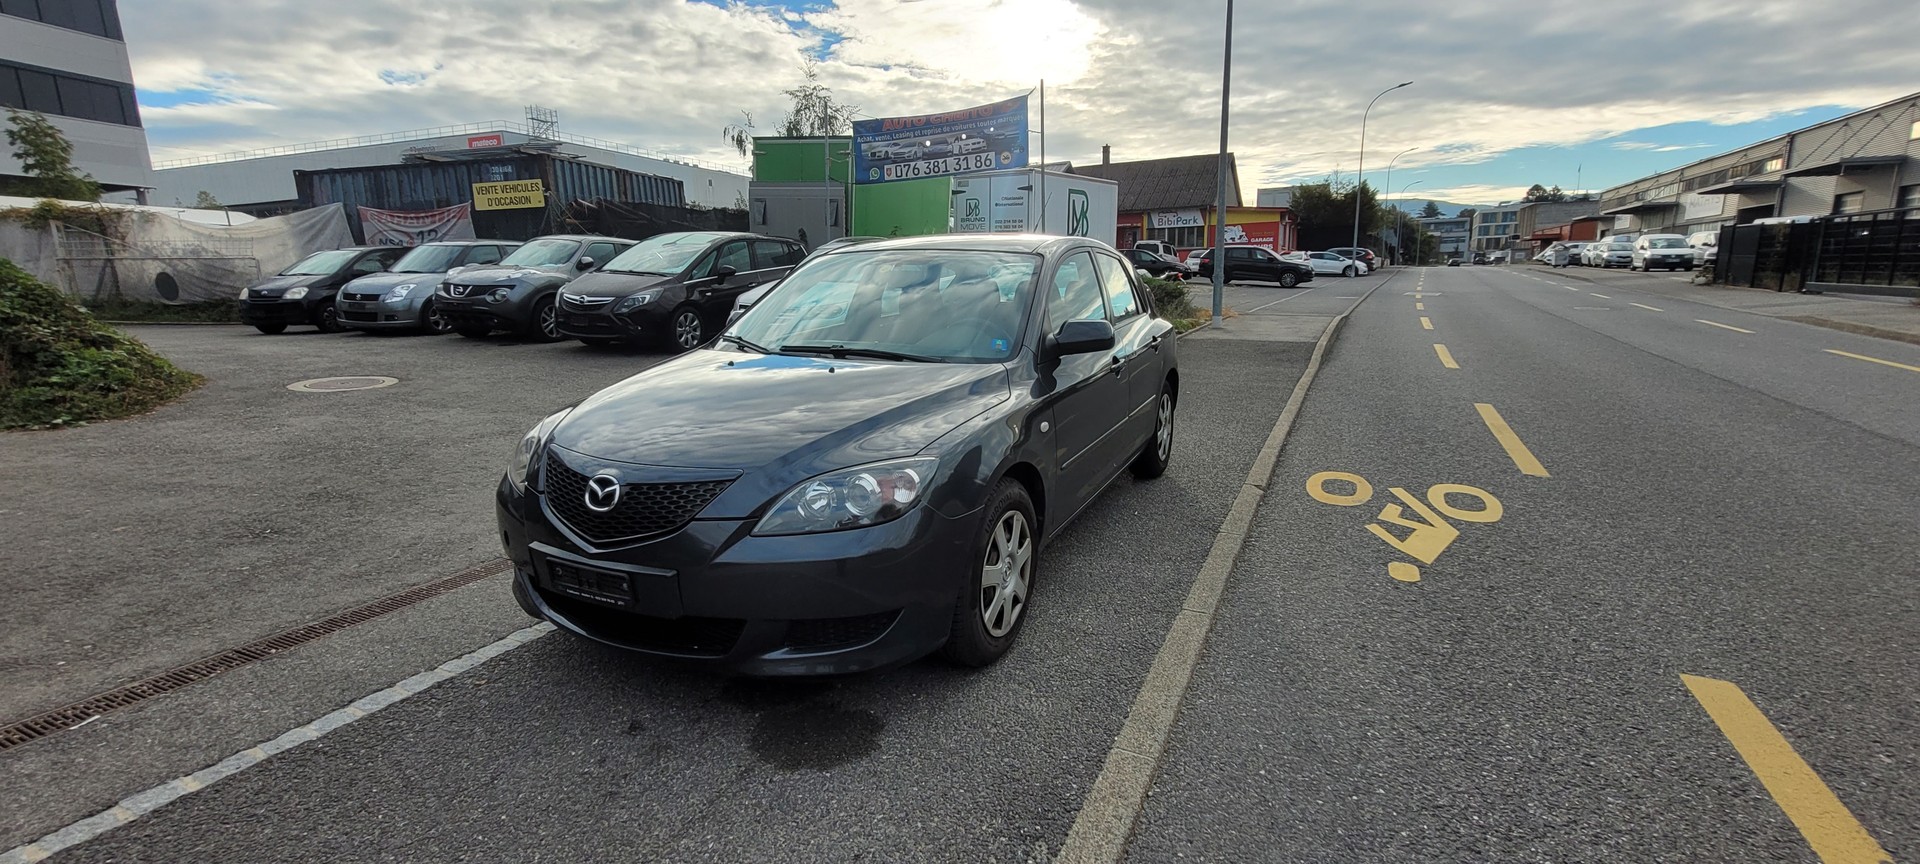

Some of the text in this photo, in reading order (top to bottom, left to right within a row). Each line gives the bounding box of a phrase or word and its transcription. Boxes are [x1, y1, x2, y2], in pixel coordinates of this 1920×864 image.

[882, 116, 926, 131] AUTO
[893, 131, 914, 140] Leasing
[922, 126, 942, 137] reprise
[951, 122, 976, 132] voitures
[977, 119, 997, 128] toutes
[997, 114, 1024, 124] marques
[472, 138, 498, 148] mateco
[895, 153, 993, 178] 076 381 31 86
[475, 182, 541, 196] VENTE VEHICULES
[487, 195, 532, 207] D'OCCASION
[1157, 216, 1199, 226] BibiPark
